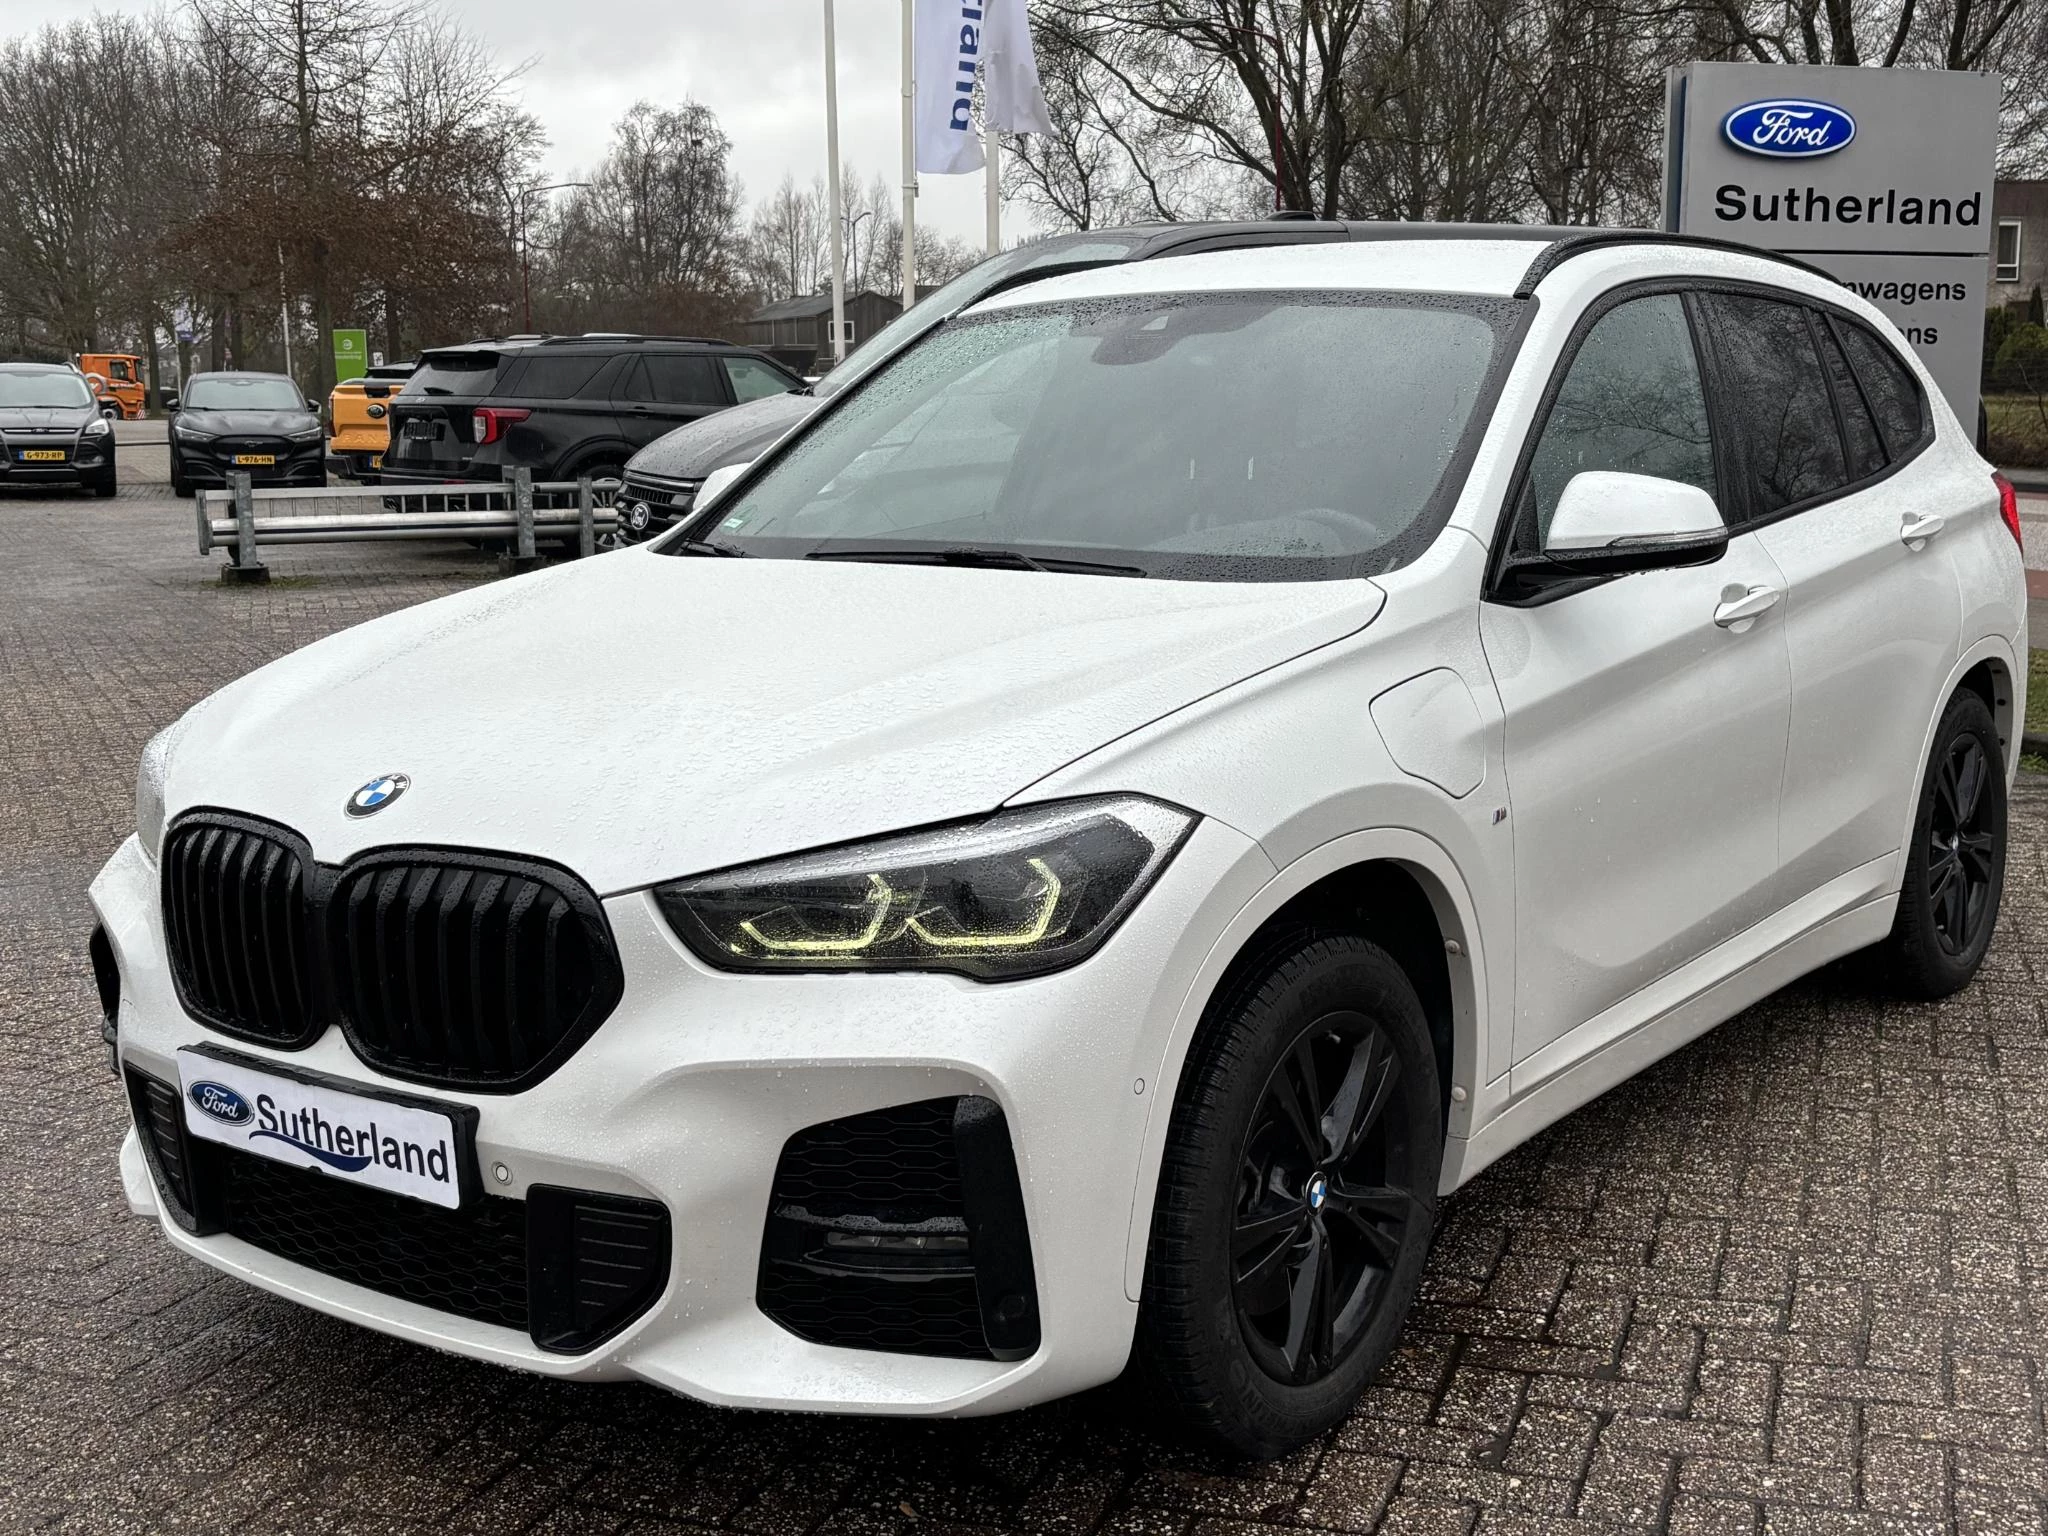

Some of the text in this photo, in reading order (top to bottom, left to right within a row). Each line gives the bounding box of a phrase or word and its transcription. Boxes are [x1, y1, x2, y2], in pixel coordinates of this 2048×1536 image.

[1753, 108, 1832, 146] Ford
[1714, 184, 1982, 227] Sutherland
[1899, 327, 1938, 345] ns
[201, 1086, 450, 1183] Ford Sutherland
